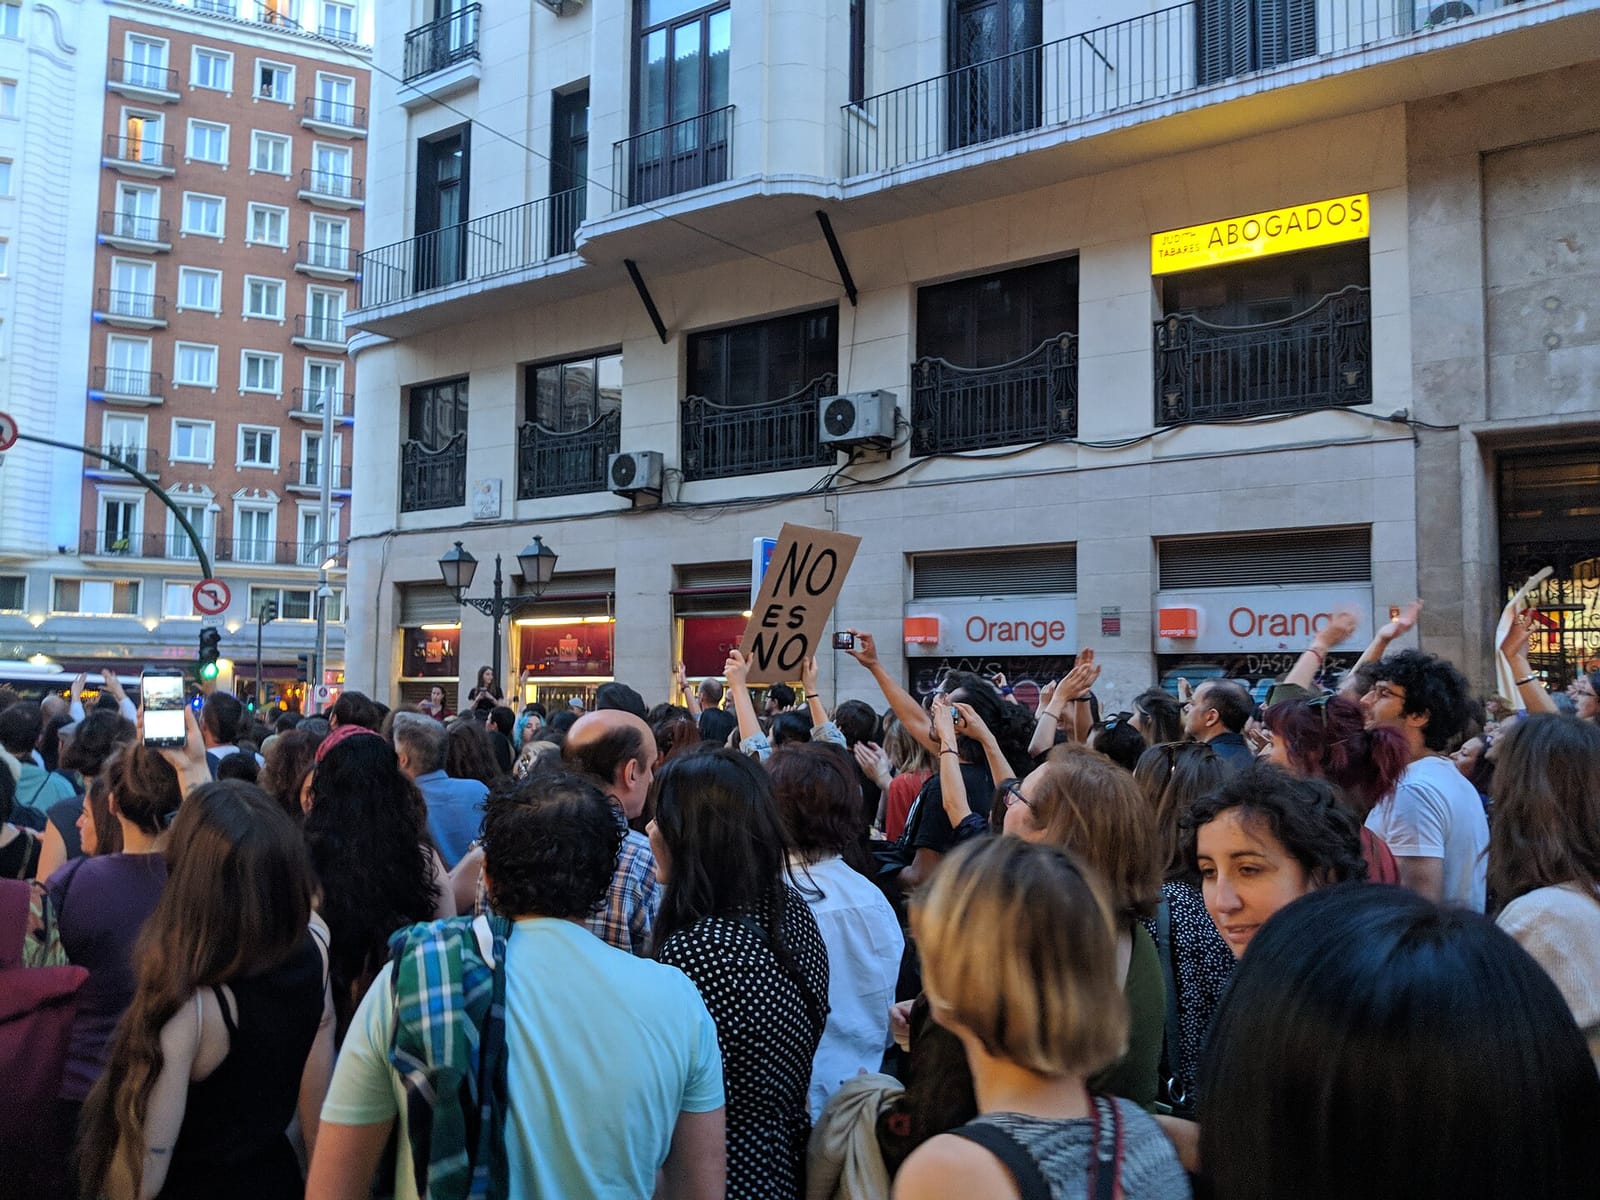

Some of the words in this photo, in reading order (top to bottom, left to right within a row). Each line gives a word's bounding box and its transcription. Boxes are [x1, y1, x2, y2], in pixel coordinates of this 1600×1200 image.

[1207, 199, 1363, 249] ABOGADOS
[772, 540, 838, 598] NO
[762, 604, 807, 629] ES
[965, 615, 1066, 648] Orange
[1228, 606, 1333, 638] Oran
[751, 631, 809, 672] NO
